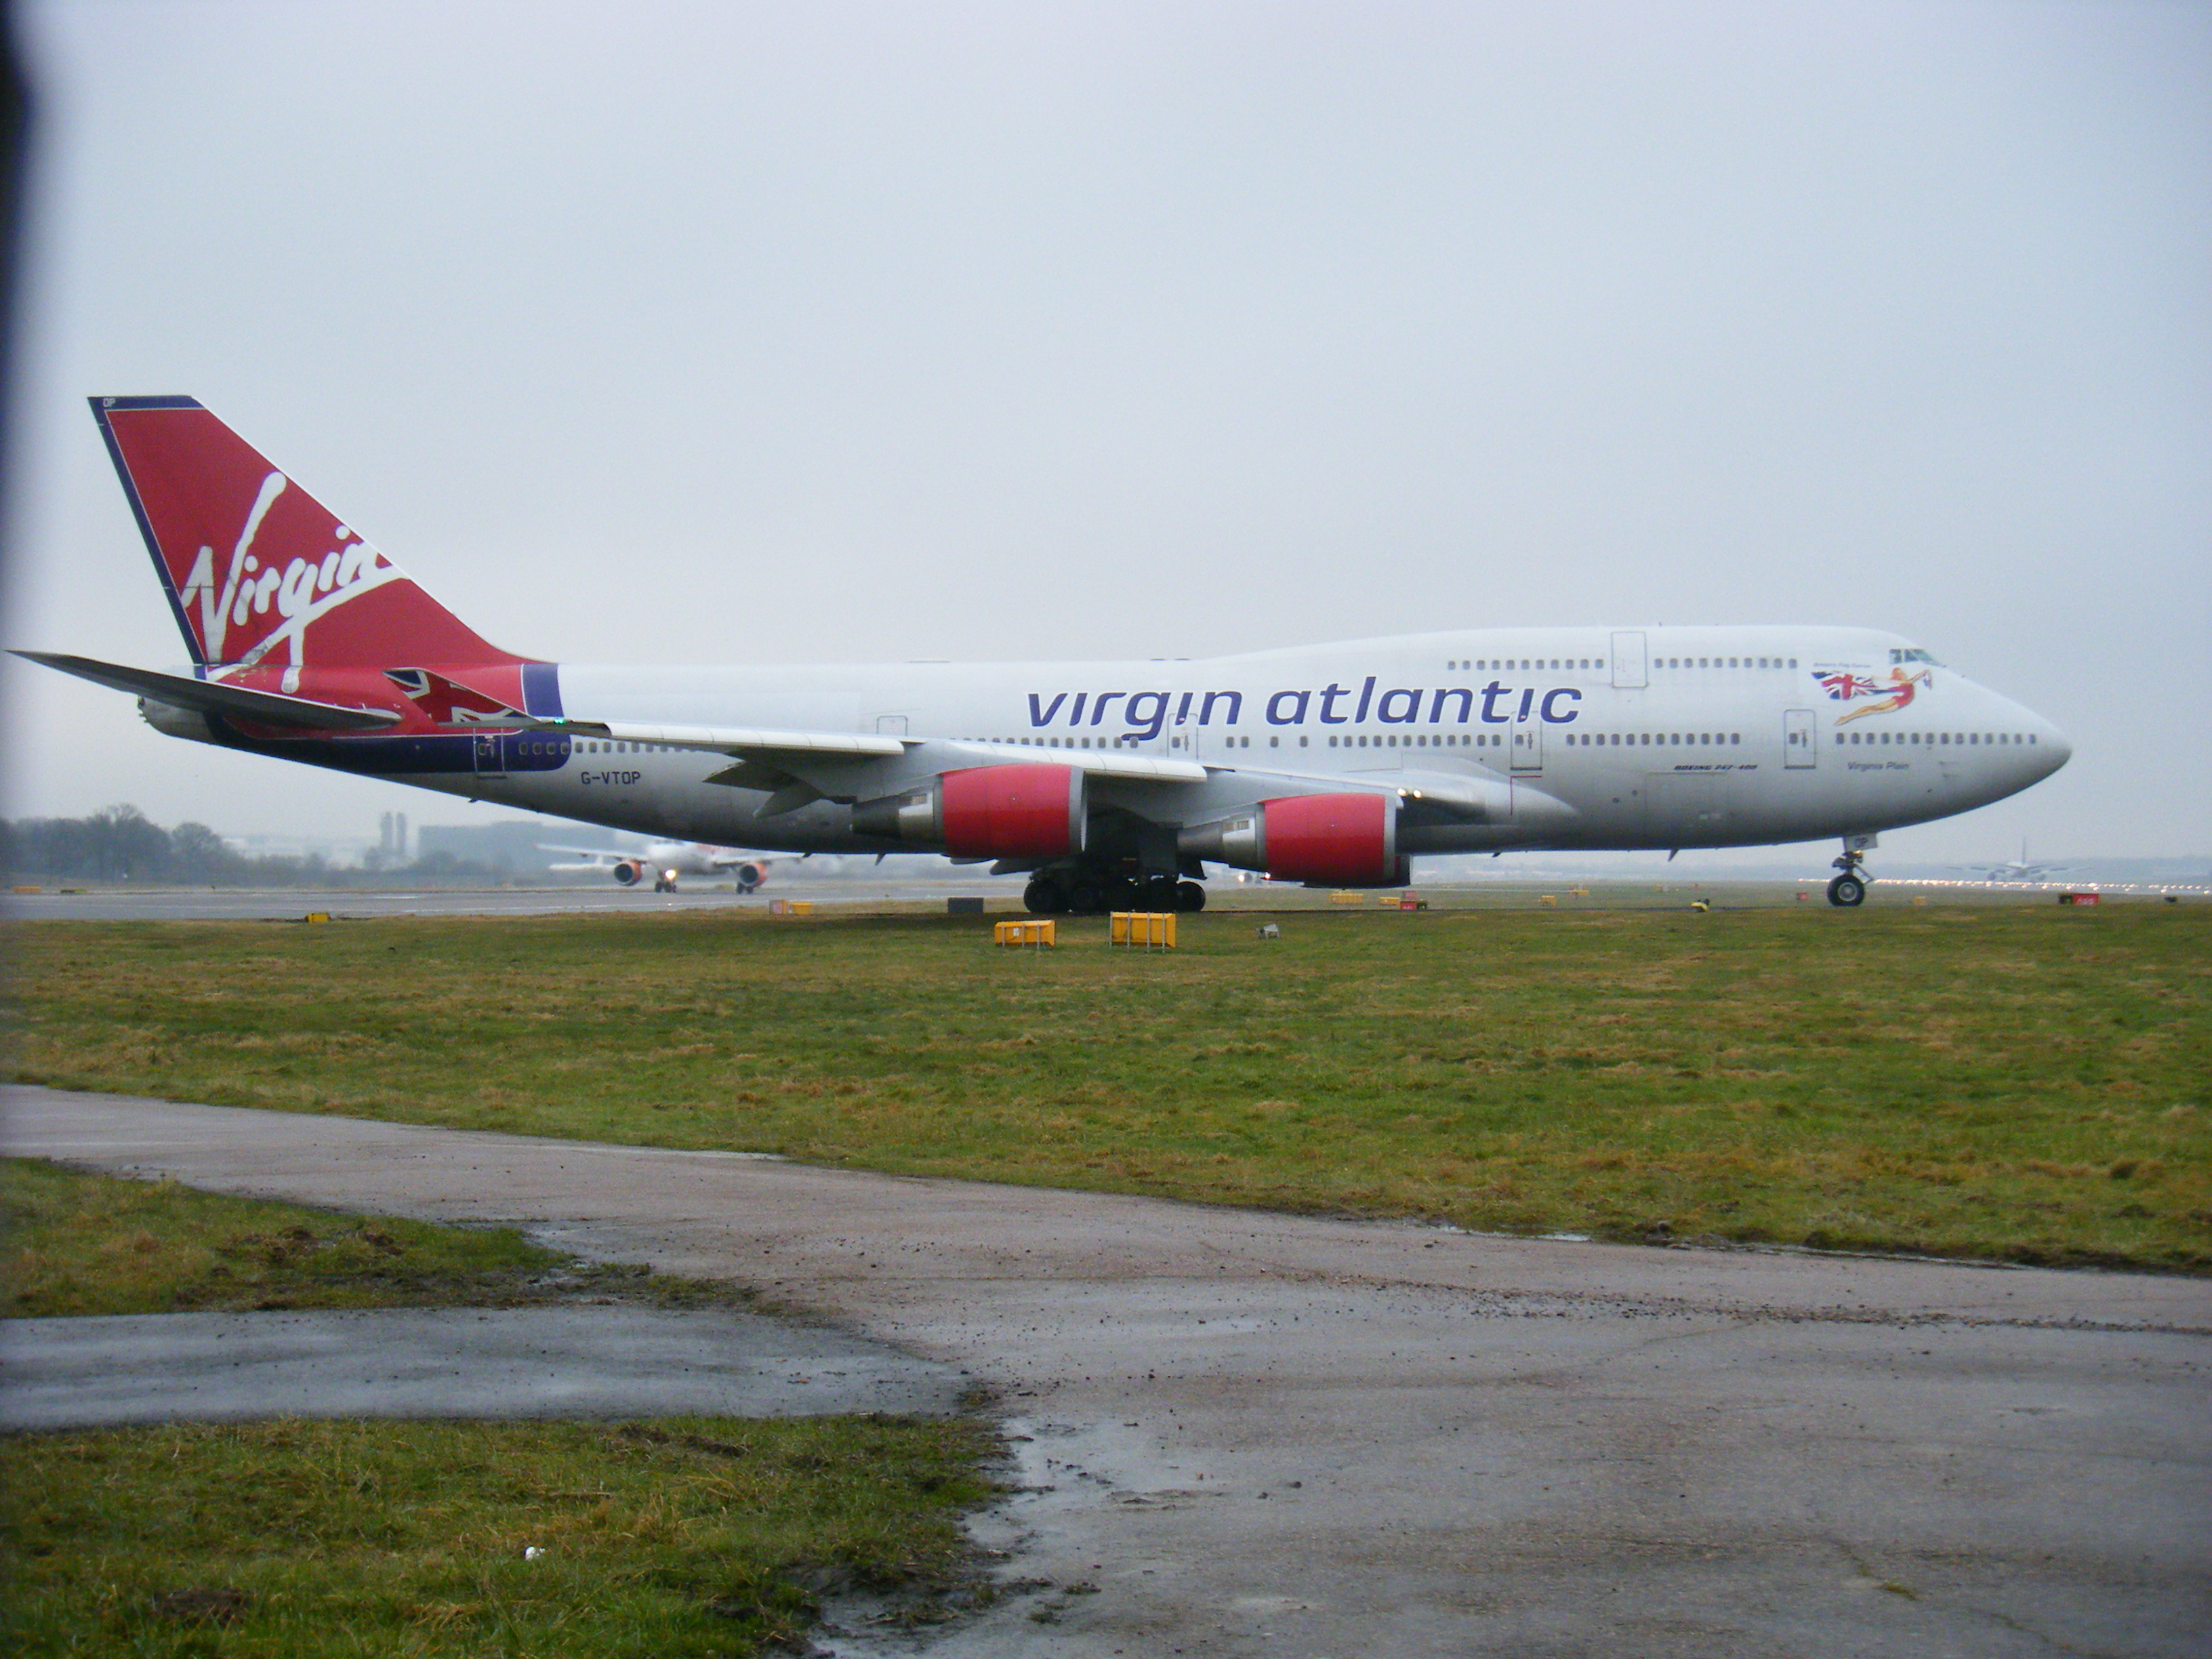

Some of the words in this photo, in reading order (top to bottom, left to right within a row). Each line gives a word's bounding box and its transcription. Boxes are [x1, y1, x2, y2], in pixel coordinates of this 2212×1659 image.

[180, 471, 410, 693] Virgin
[1028, 691, 1242, 741] virgin
[1266, 676, 1582, 724] atlantic
[581, 771, 640, 784] G-VTOP
